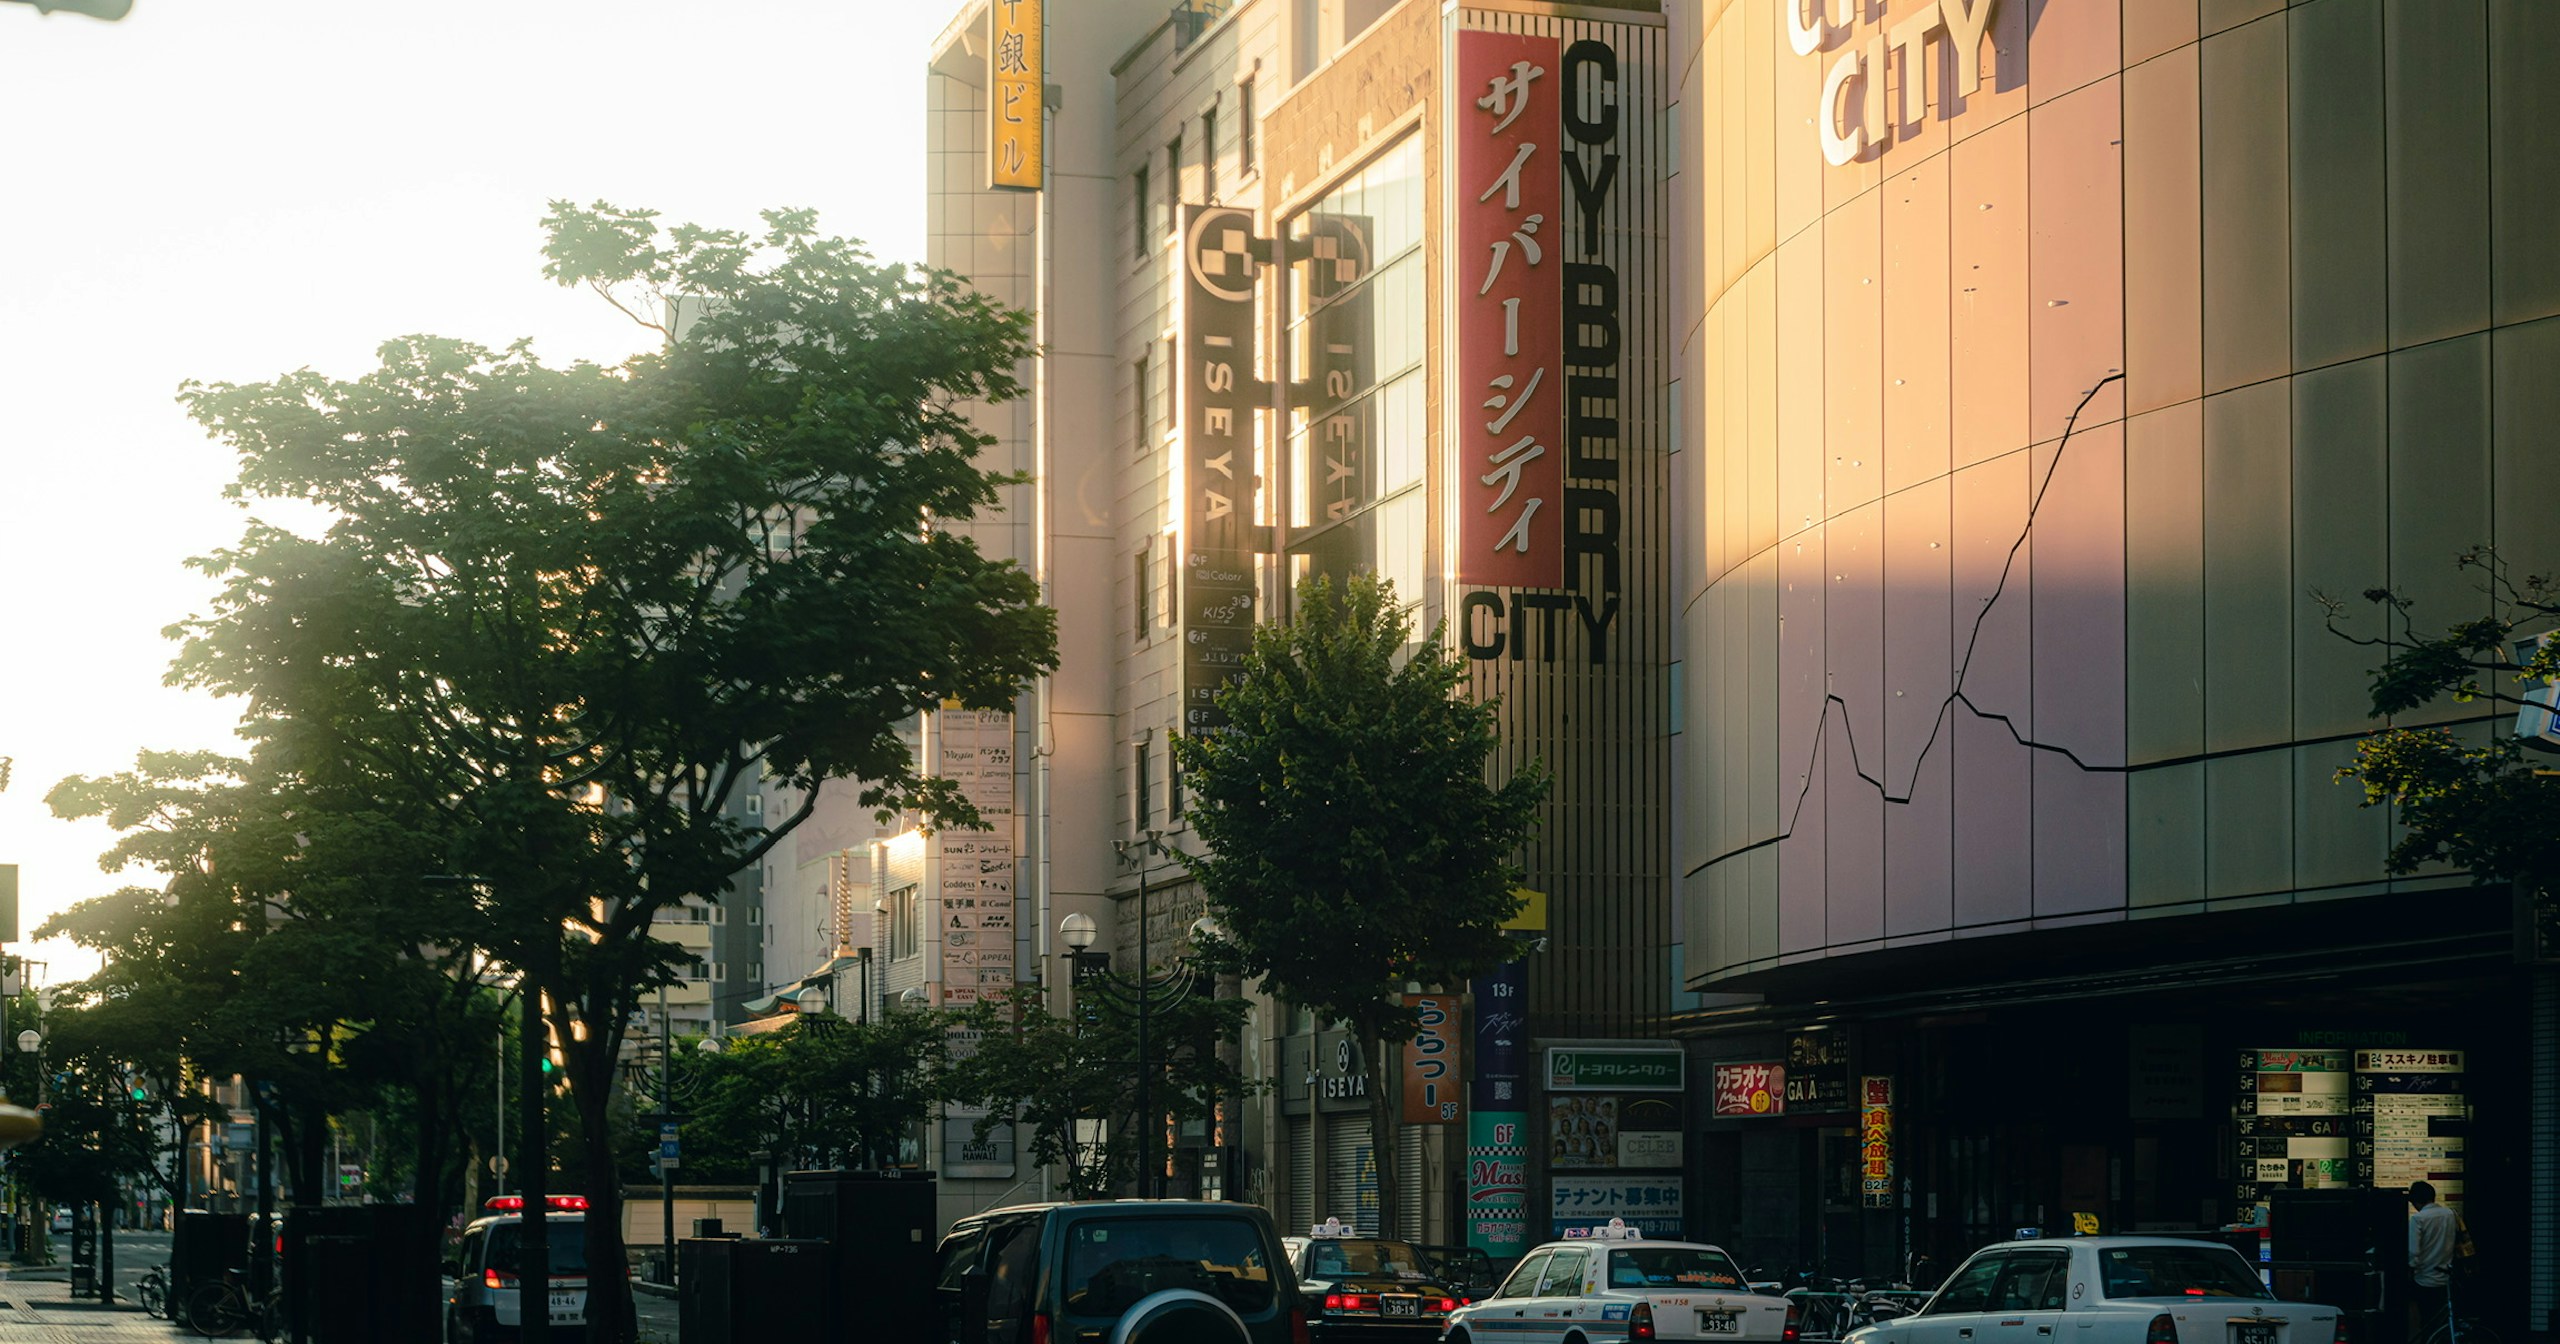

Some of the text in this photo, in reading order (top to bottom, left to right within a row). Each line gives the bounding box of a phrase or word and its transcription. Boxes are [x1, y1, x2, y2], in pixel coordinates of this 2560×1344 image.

[1819, 0, 1993, 167] CITY
[1477, 60, 1545, 553] サイバーシティ
[1561, 39, 1620, 591] CYBER
[1203, 334, 1234, 522] ISEYA
[1203, 606, 1236, 620] KISS
[1461, 590, 1620, 665] CITY
[944, 750, 974, 761] Virgin
[944, 881, 975, 889] Goddess
[1492, 982, 1514, 998] 13F
[2240, 1053, 2254, 1069] 6F
[1578, 1064, 1677, 1076] トヨタレンタカー
[1716, 1065, 1770, 1090] カラオケ
[1322, 1075, 1365, 1098] ISEYA
[2240, 1075, 2254, 1090] 5F
[1755, 1092, 1766, 1111] 6F
[2240, 1098, 2254, 1113] 4F
[1441, 1102, 1458, 1120] 5F
[1494, 1123, 1516, 1146] 6F
[2240, 1120, 2254, 1135] 3F
[2355, 1120, 2373, 1135] 11F
[962, 1144, 997, 1152] ALWAYS
[1627, 1139, 1676, 1153] CELEB
[2240, 1141, 2253, 1156] 2F
[2355, 1140, 2373, 1156] 10F
[962, 1152, 997, 1161] HAWAII
[2240, 1163, 2254, 1178] 1F
[2358, 1162, 2373, 1178] 9F
[1865, 1180, 1889, 1190] B2F
[2237, 1185, 2257, 1199] B1F
[1555, 1187, 1680, 1206] テナント募集中
[551, 1297, 576, 1306] 48-46
[1674, 1298, 1689, 1306] 158
[1390, 1305, 1415, 1315] 30-19
[1708, 1320, 1736, 1331] 93-40
